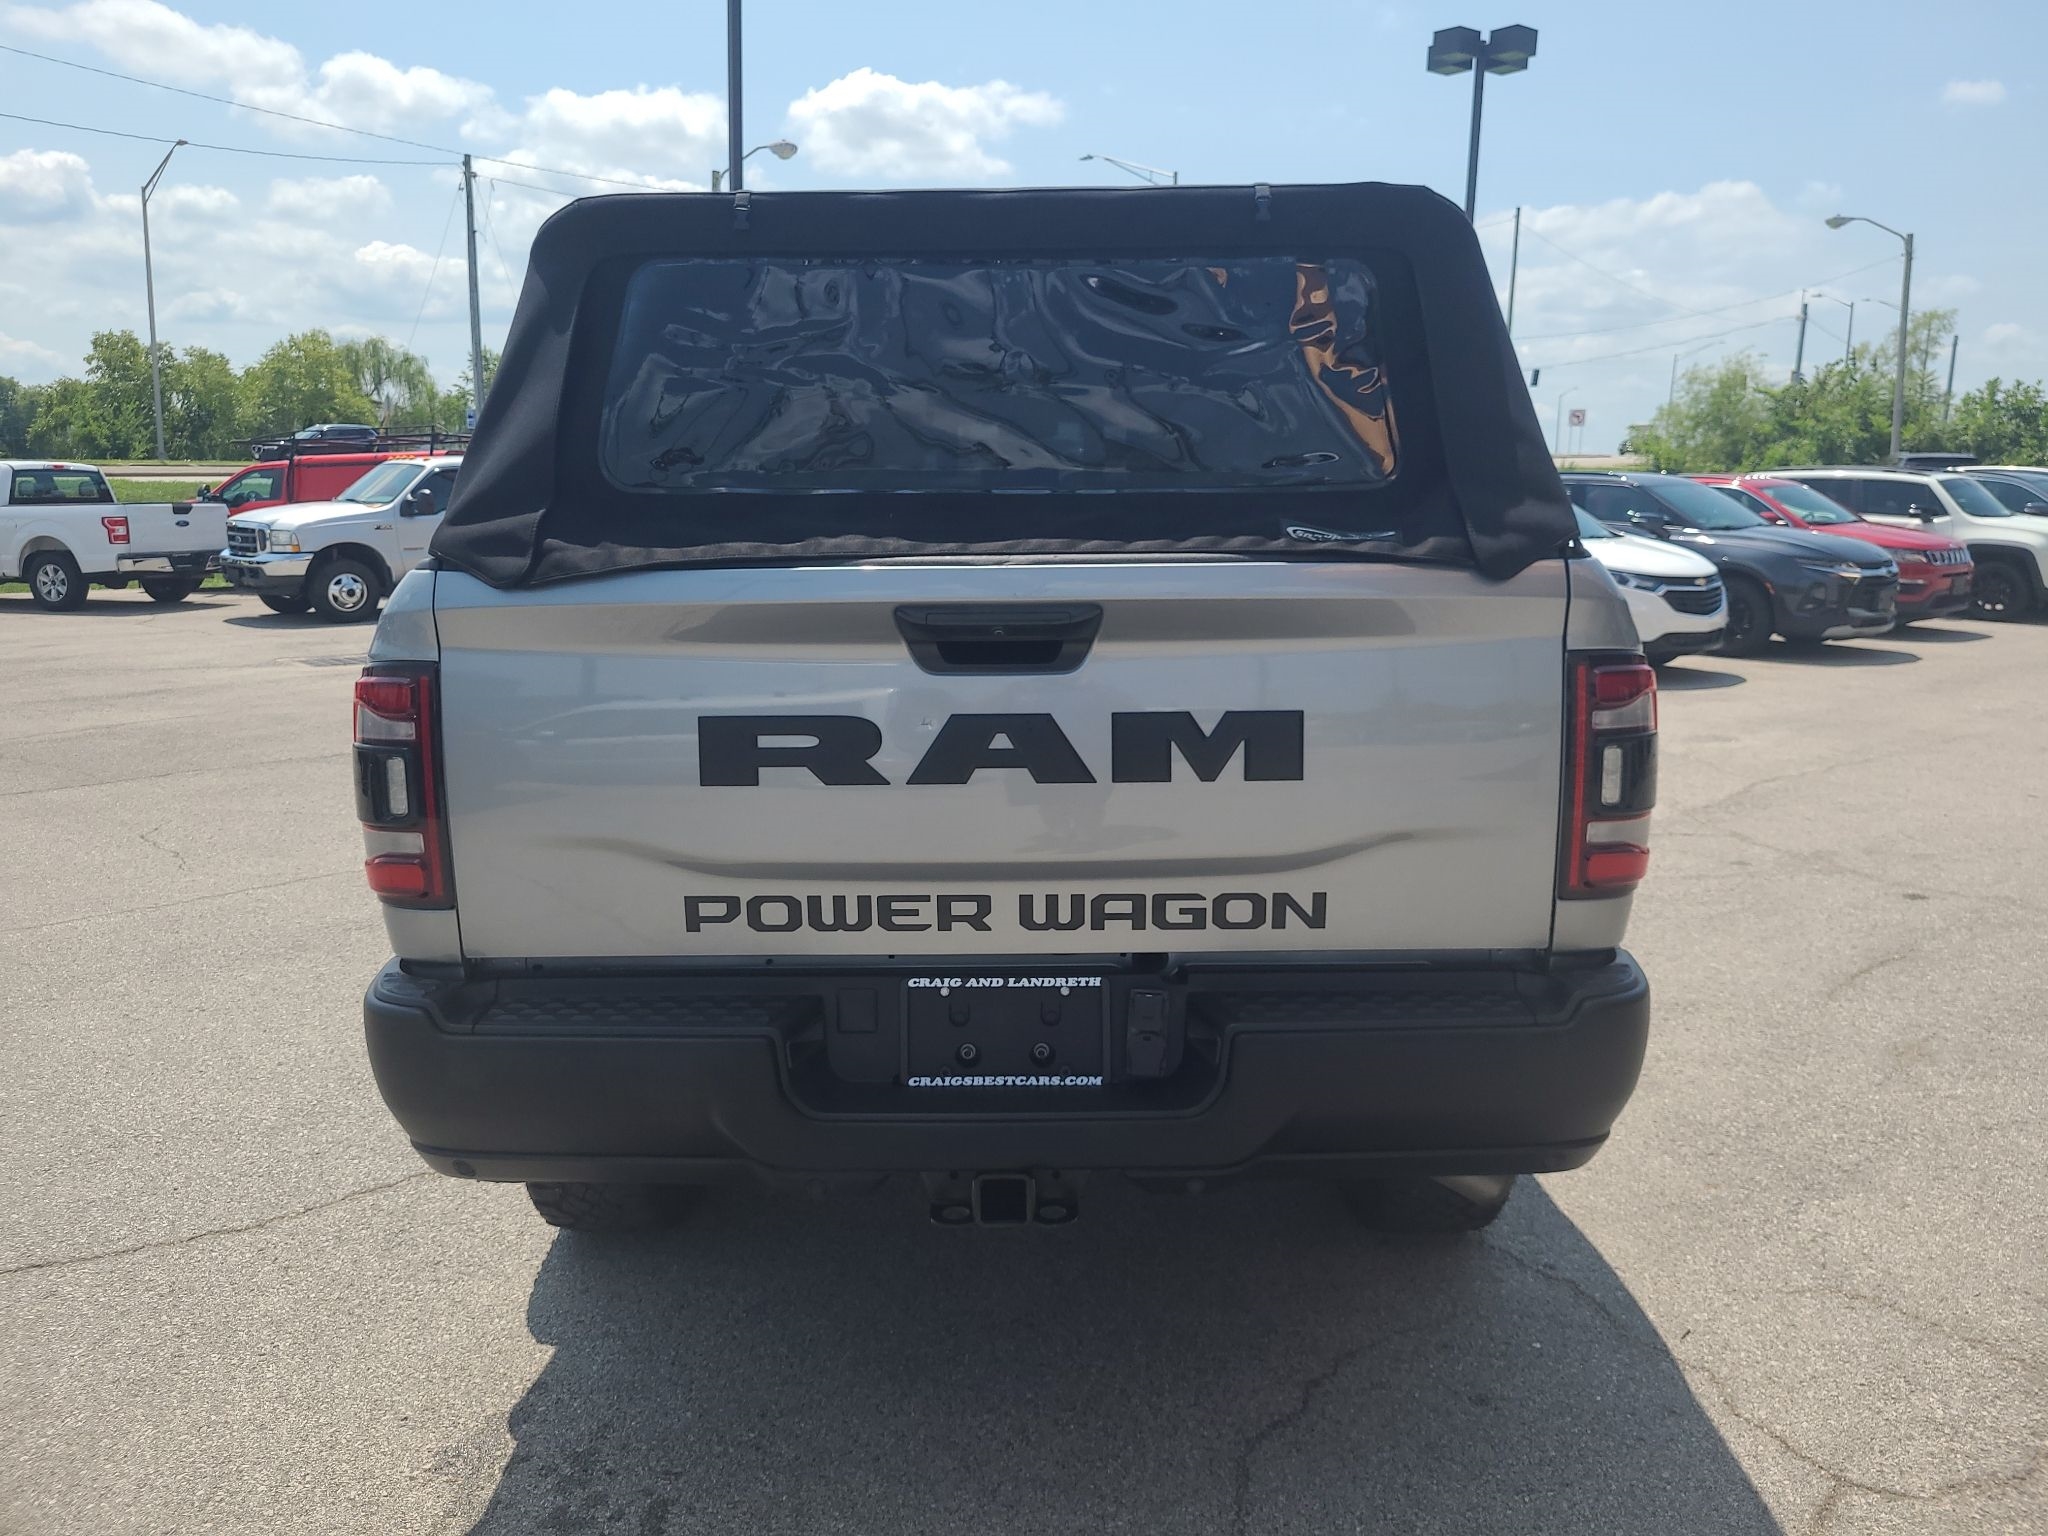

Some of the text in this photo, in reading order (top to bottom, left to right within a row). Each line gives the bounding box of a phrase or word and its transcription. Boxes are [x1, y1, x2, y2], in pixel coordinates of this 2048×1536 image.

[697, 709, 1305, 787] RAM
[683, 891, 1328, 933] POWER WAGON
[907, 976, 1102, 988] CRAIG AND LANDRETH
[907, 1075, 1103, 1087] CRAIGSBESTCARS.COM
